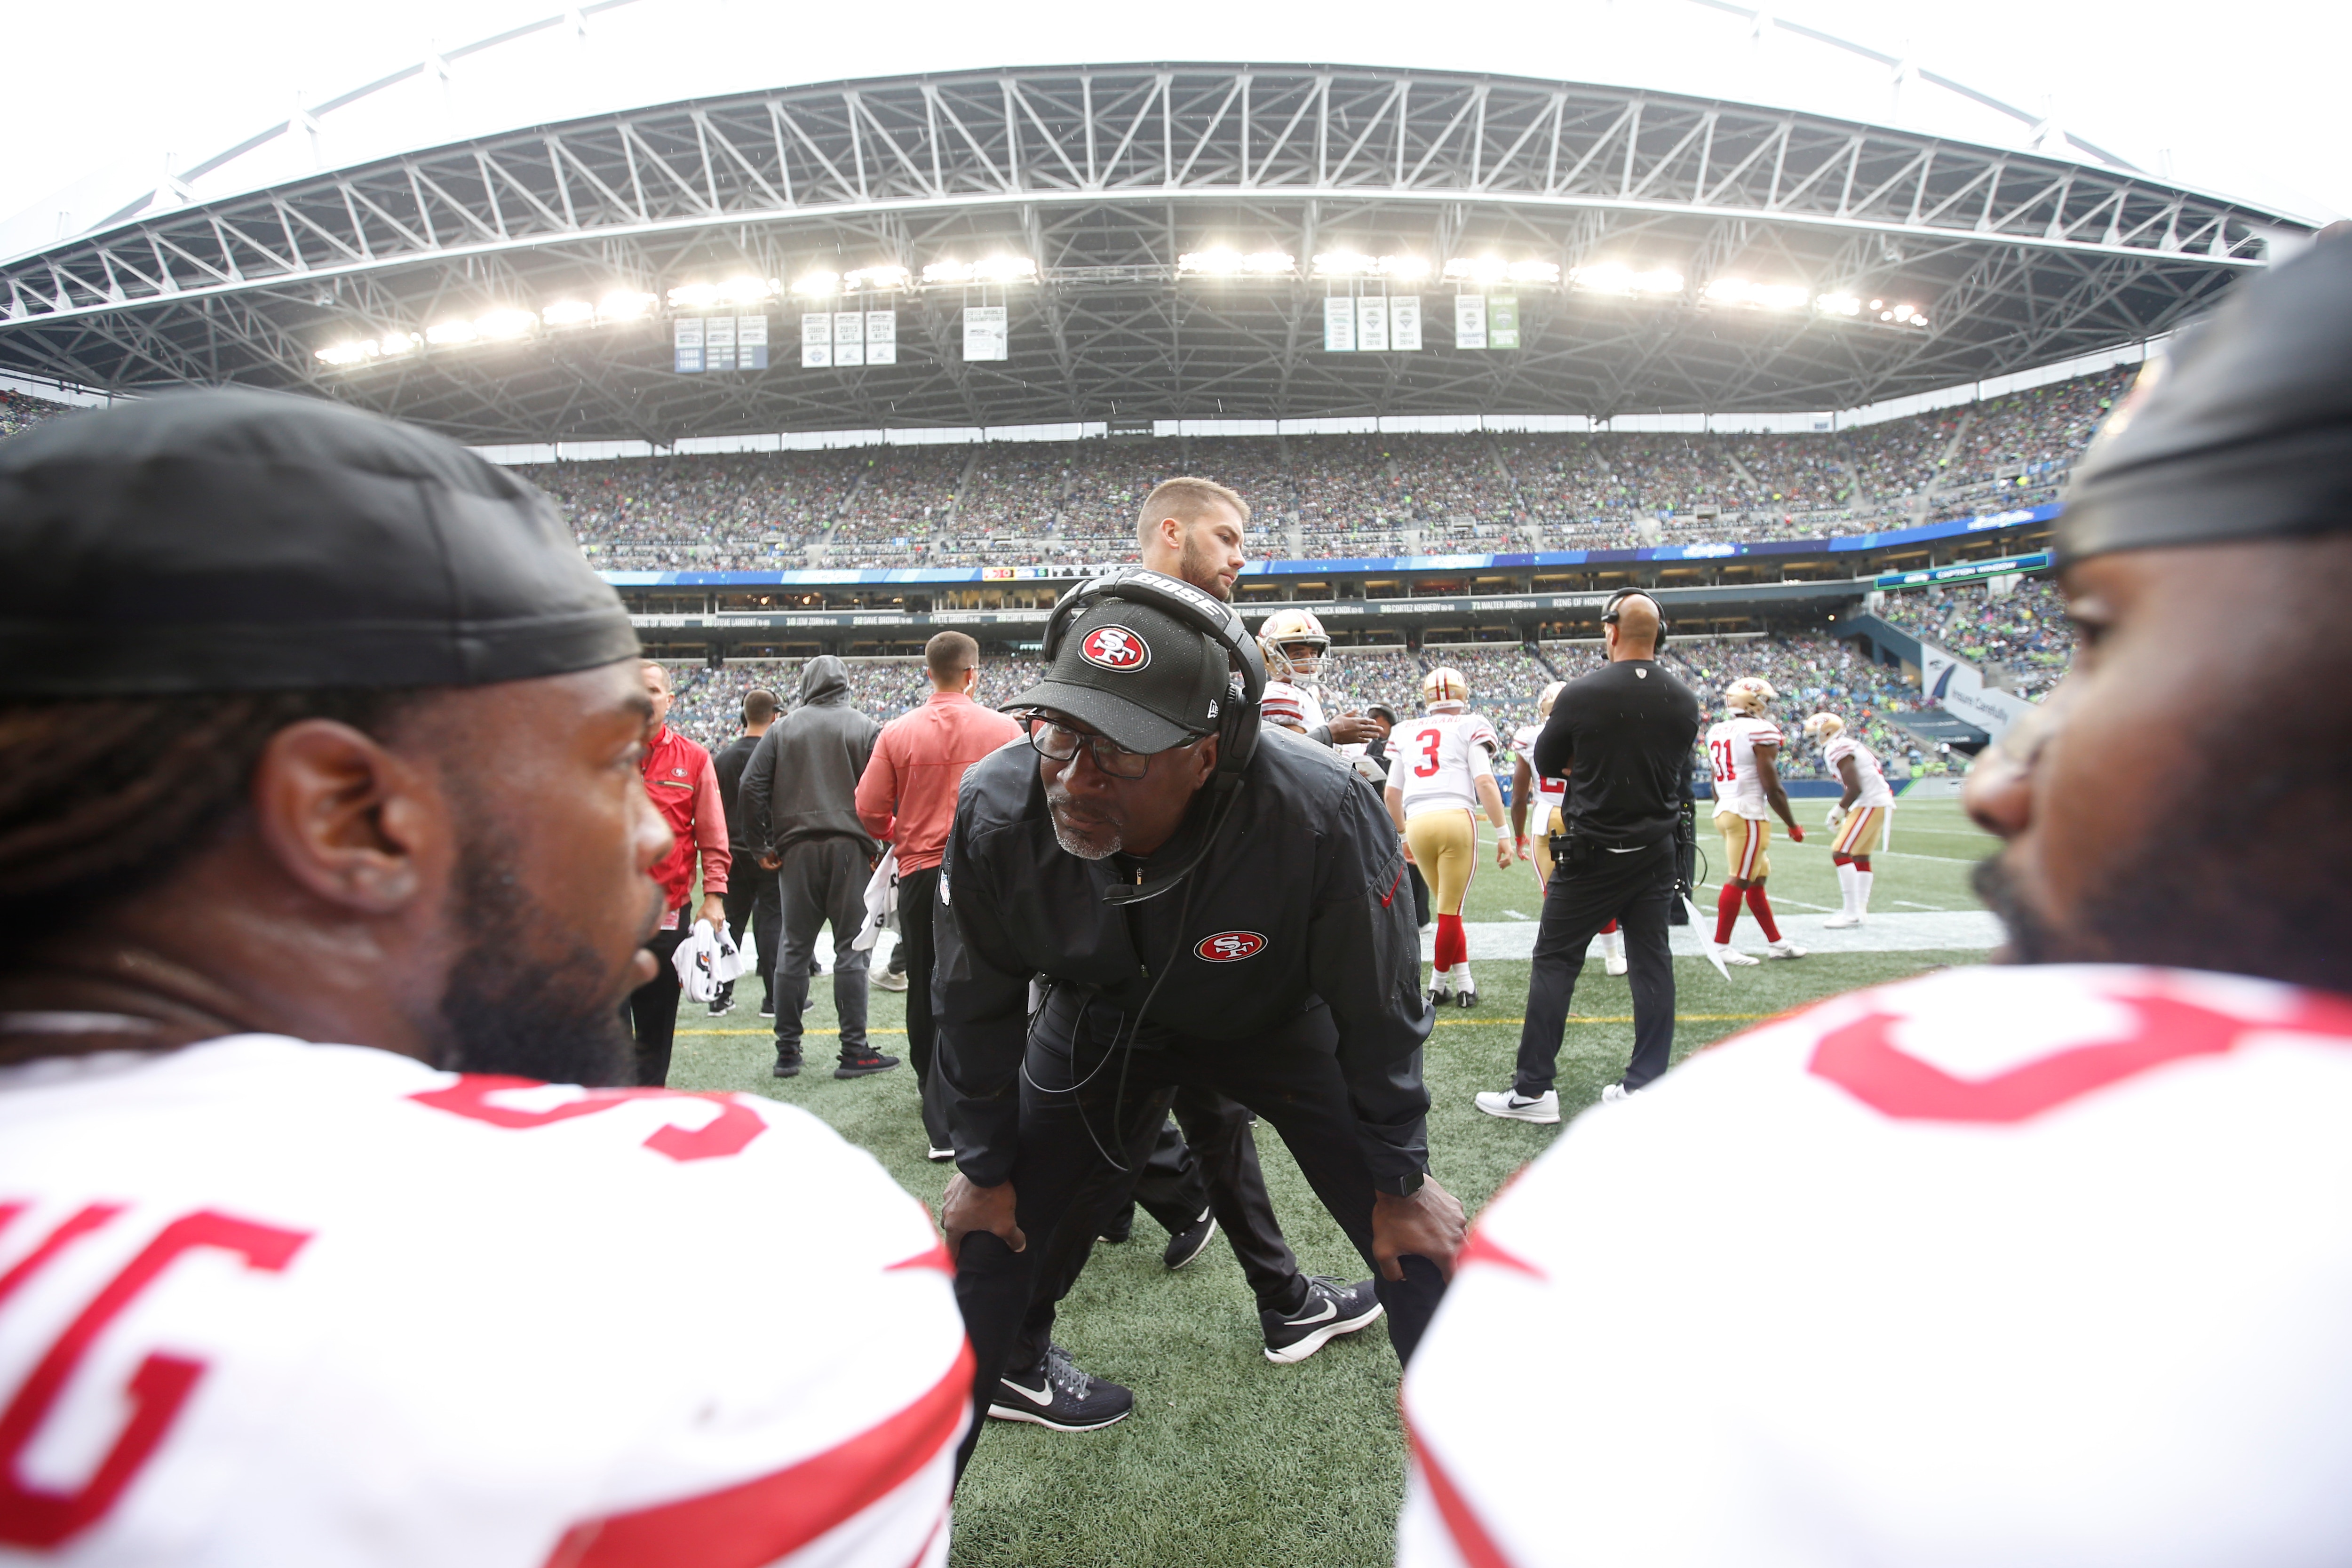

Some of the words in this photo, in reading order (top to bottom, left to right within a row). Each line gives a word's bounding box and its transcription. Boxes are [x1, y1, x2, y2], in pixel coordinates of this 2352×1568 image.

[1037, 568, 1046, 577] 6
[1132, 572, 1220, 616] BOSE
[1482, 601, 1503, 609] WALTER
[1504, 600, 1523, 609] JONES
[1553, 597, 1572, 607] RING
[1574, 597, 1583, 606] OF
[1242, 608, 1256, 617] DAVE
[1314, 607, 1334, 615] CHUCK
[1335, 606, 1351, 615] KNOX
[1380, 605, 1391, 613] 96
[1392, 604, 1413, 613] CORTEZ
[1414, 603, 1440, 612] KENNEDY
[649, 618, 659, 628] OF
[660, 618, 685, 628] HONOR
[713, 618, 731, 627] STEVE
[731, 618, 756, 627] LARGENT
[796, 617, 808, 626] JIM
[808, 617, 823, 626] ZORN
[853, 617, 863, 626] 22
[863, 617, 878, 625] DAVE
[878, 616, 899, 625] BROWN
[934, 615, 947, 623] PETE
[948, 614, 967, 623] GROSS
[1007, 614, 1022, 623] CURT
[1023, 613, 1046, 622] WARNER
[1976, 697, 2008, 724] Carefully
[1414, 728, 1441, 778] 3
[1710, 739, 1736, 782] 31
[1213, 935, 1254, 958] SF
